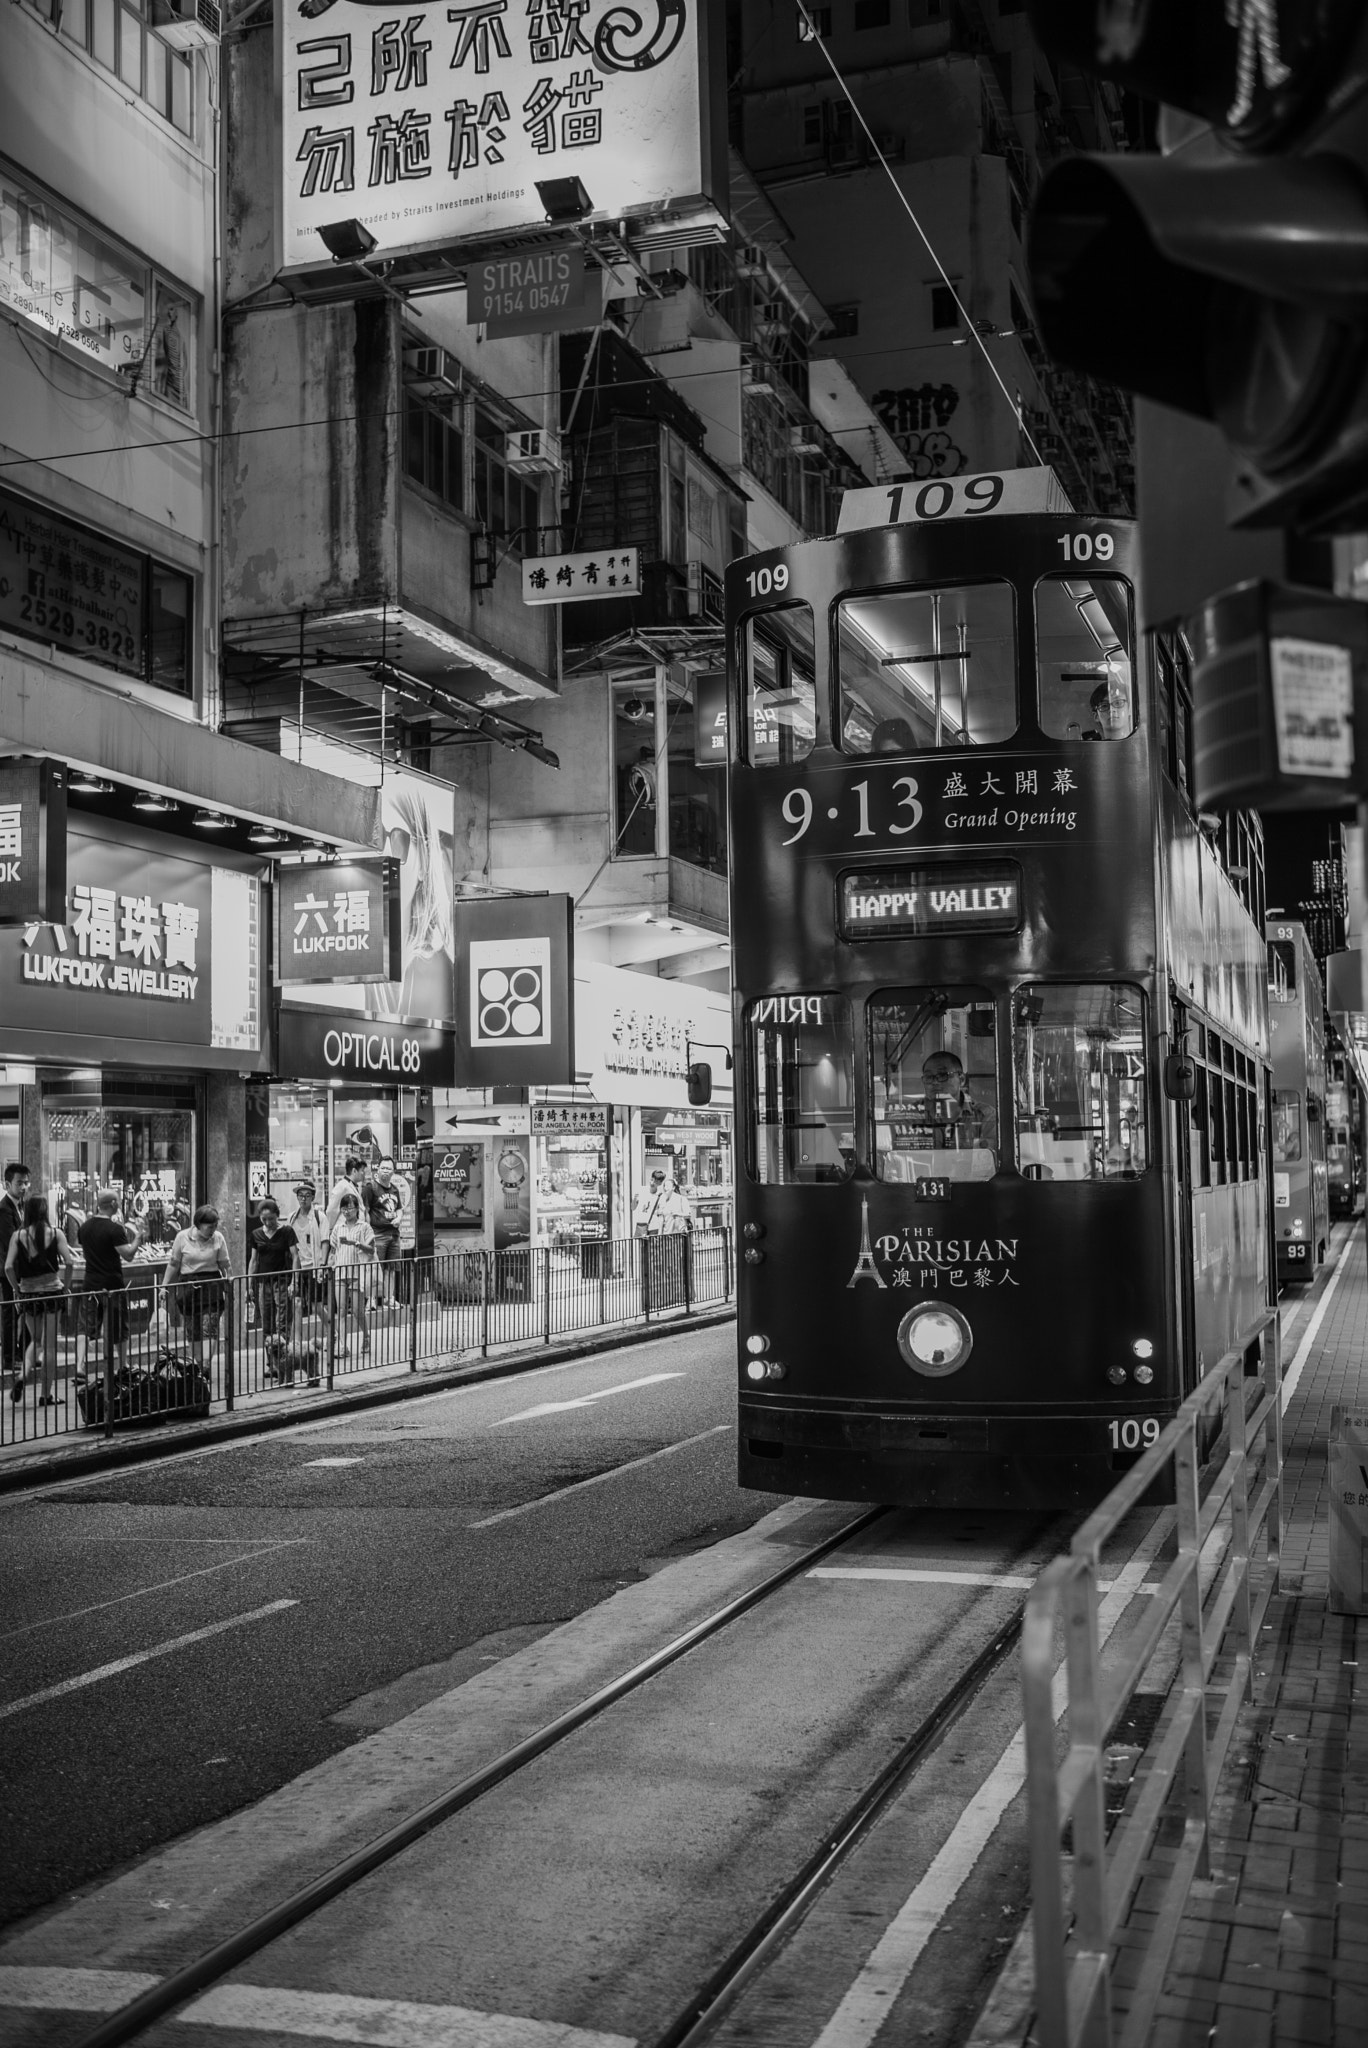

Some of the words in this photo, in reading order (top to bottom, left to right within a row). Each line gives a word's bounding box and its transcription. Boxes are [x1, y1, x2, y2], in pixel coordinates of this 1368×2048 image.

[296, 70, 603, 197] 勿施於貓
[392, 210, 401, 220] by
[404, 205, 433, 217] Straits
[436, 194, 484, 211] Investment
[486, 188, 525, 202] Holdings
[484, 254, 570, 291] STRAITS
[484, 288, 524, 317] 9154
[529, 283, 570, 311] 0547
[13, 293, 33, 313] 2890
[81, 334, 100, 353] 0506
[886, 475, 1004, 524] 109
[24, 515, 52, 540] Herbal
[54, 529, 70, 549] Hair
[1057, 533, 1114, 561] 109
[746, 564, 789, 597] 109
[20, 594, 136, 661] 2529-3828
[942, 768, 1078, 799] 盛大開幕
[945, 808, 998, 829] Grand
[1004, 807, 1078, 832] Opening
[293, 890, 370, 935] 六福
[850, 893, 918, 918] HAPPY
[930, 887, 1013, 912] VALLEY
[293, 934, 370, 954] LUKFOOK
[1277, 927, 1294, 940] 93
[24, 953, 105, 989] LUKFOOK
[107, 966, 199, 1000] JEWELLERY
[323, 1030, 400, 1072] OPTICAL
[401, 1038, 421, 1073] 88
[434, 1168, 467, 1178] ENICAR
[921, 1182, 945, 1197] 131
[902, 1228, 934, 1236] THE
[875, 1235, 1019, 1270] PARISIAN
[1287, 1245, 1306, 1258] 93
[892, 1267, 1020, 1289] 澳門巴黎人
[1108, 1418, 1160, 1449] 109
